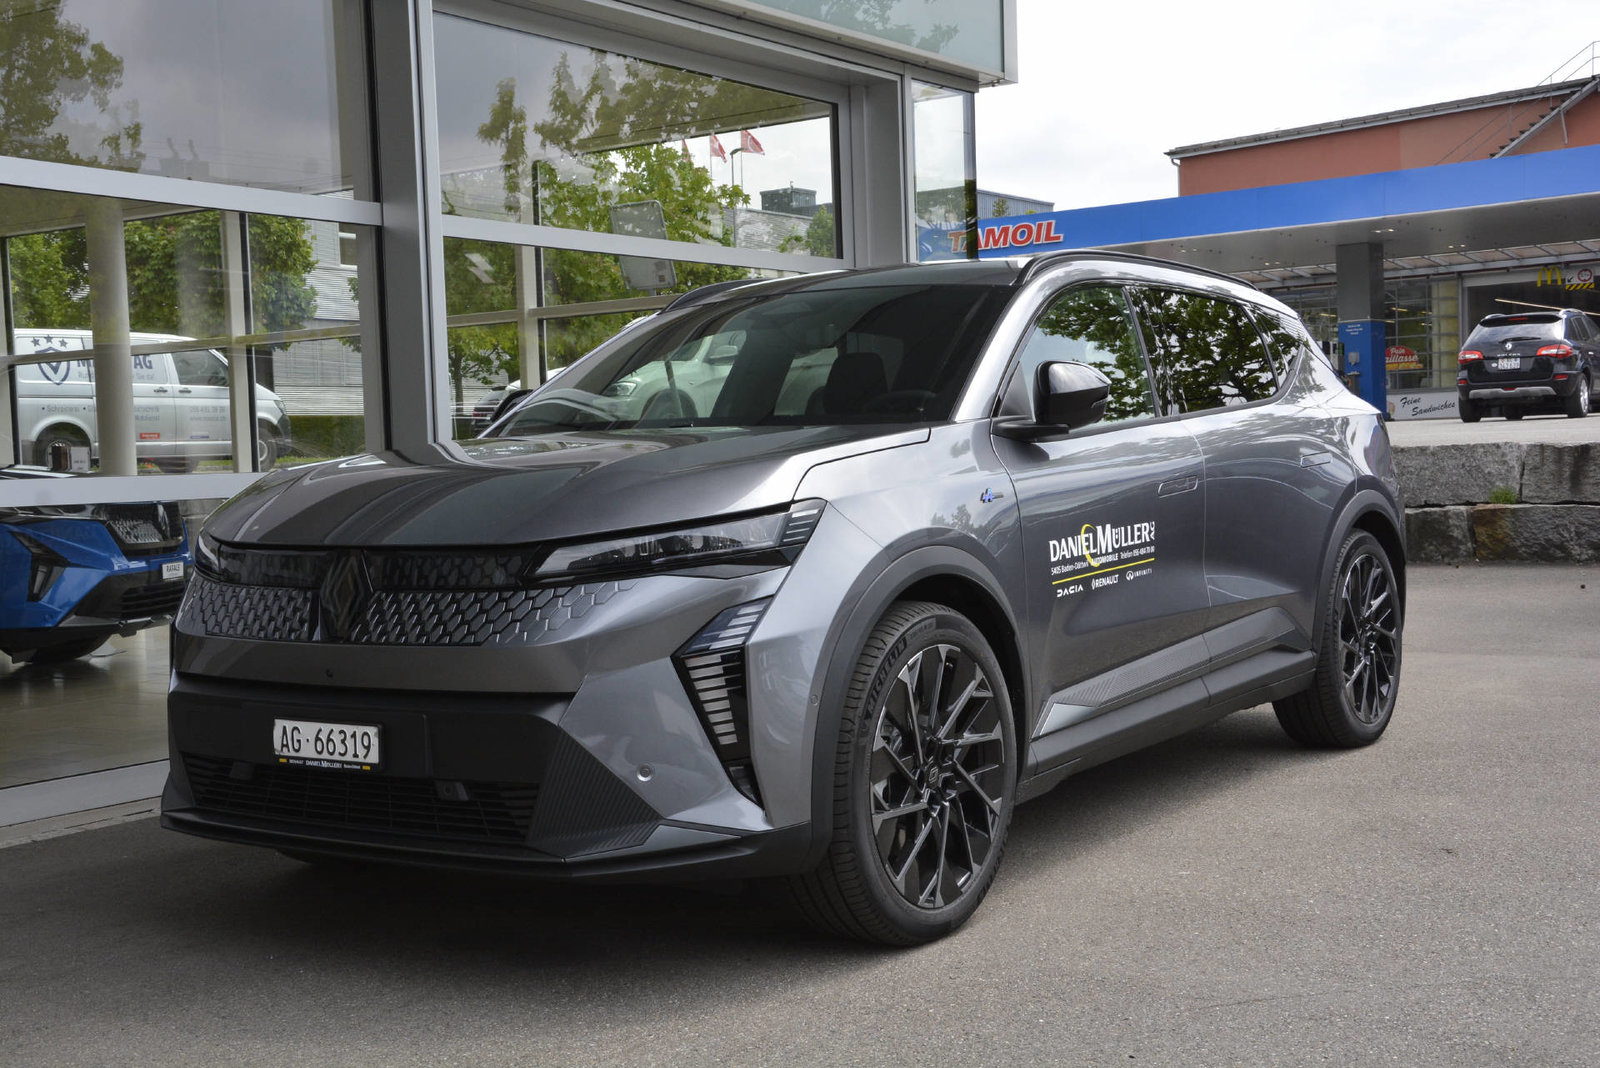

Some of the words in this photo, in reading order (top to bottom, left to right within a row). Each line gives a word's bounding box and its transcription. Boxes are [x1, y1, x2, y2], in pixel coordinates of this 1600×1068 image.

[1400, 396, 1421, 408] Feine
[1411, 401, 1456, 417] Sandwiches
[1048, 532, 1097, 562] DANIEL
[1095, 522, 1151, 555] MÜLLER
[1091, 552, 1119, 566] AUTOMOBILE
[1056, 583, 1084, 598] DACIA
[1095, 574, 1119, 588] RENAULT
[863, 636, 908, 721] MICHELIN
[314, 727, 372, 760] 66319
